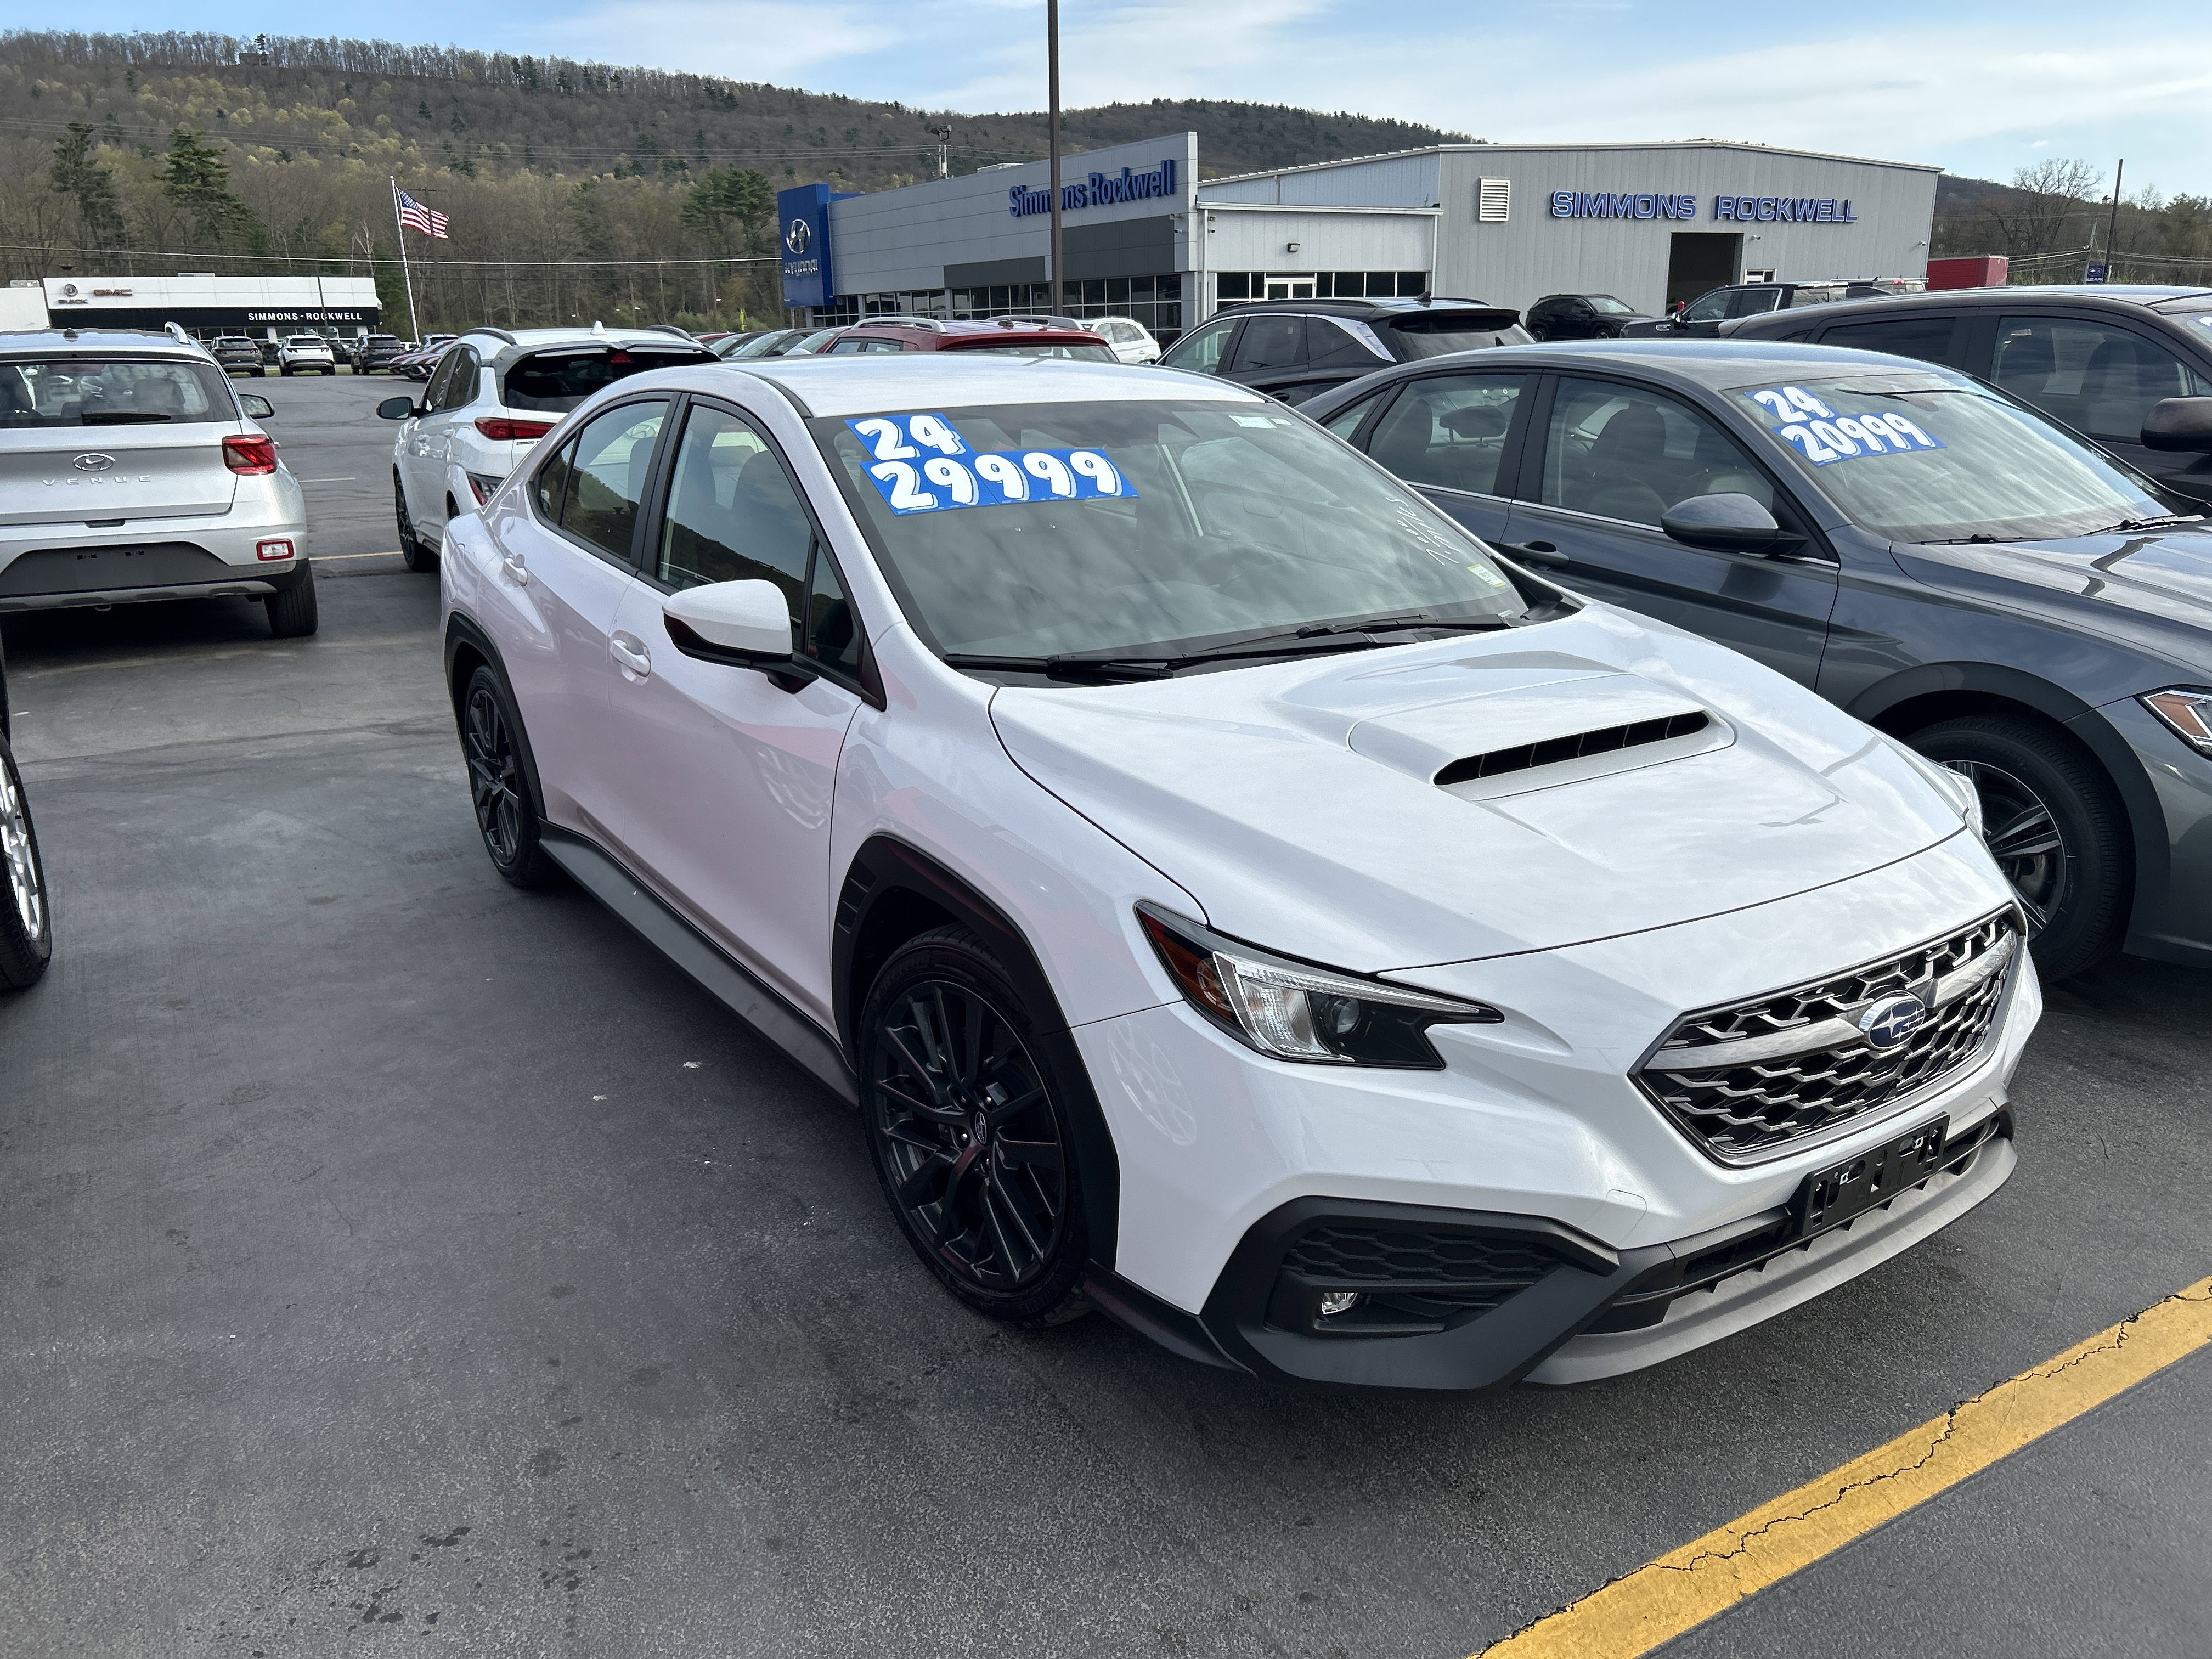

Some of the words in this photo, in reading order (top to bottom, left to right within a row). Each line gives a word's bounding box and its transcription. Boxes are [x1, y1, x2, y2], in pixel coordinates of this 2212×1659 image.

[1009, 185, 1087, 217] Simmns
[1088, 159, 1175, 206] Rockwell
[1551, 190, 1697, 220] SIMMONS
[1714, 194, 1859, 223] ROCKWELL
[93, 289, 133, 297] GMC
[1753, 386, 1835, 424] 24
[854, 415, 967, 461] 24
[1780, 413, 1937, 462] 20999
[42, 475, 151, 486] VENUE
[870, 450, 1123, 511] 29999
